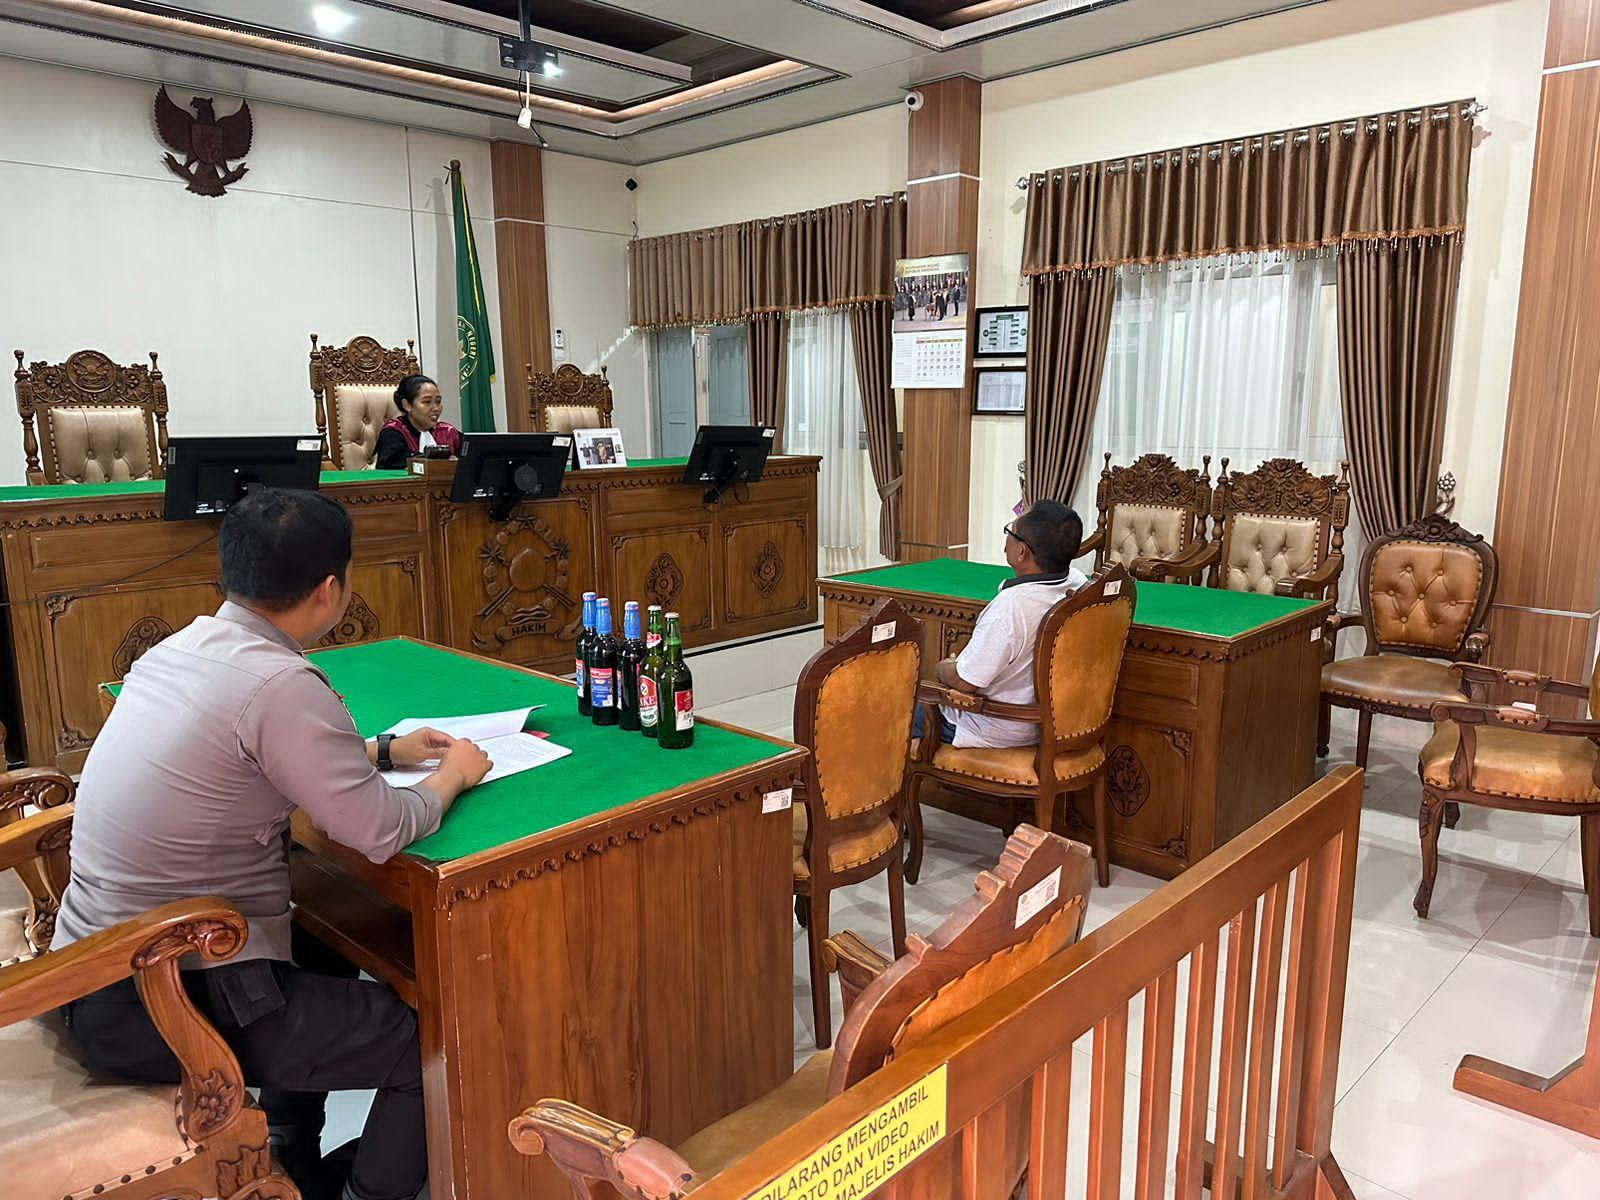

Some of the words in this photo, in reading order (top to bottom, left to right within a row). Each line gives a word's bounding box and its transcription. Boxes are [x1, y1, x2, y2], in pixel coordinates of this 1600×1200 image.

[511, 623, 546, 637] HAKIM
[847, 1085, 929, 1154] MENGAMBIL
[899, 1120, 939, 1163] HAKIM
[833, 1152, 863, 1187] DAN
[868, 1121, 909, 1160] VIDEO
